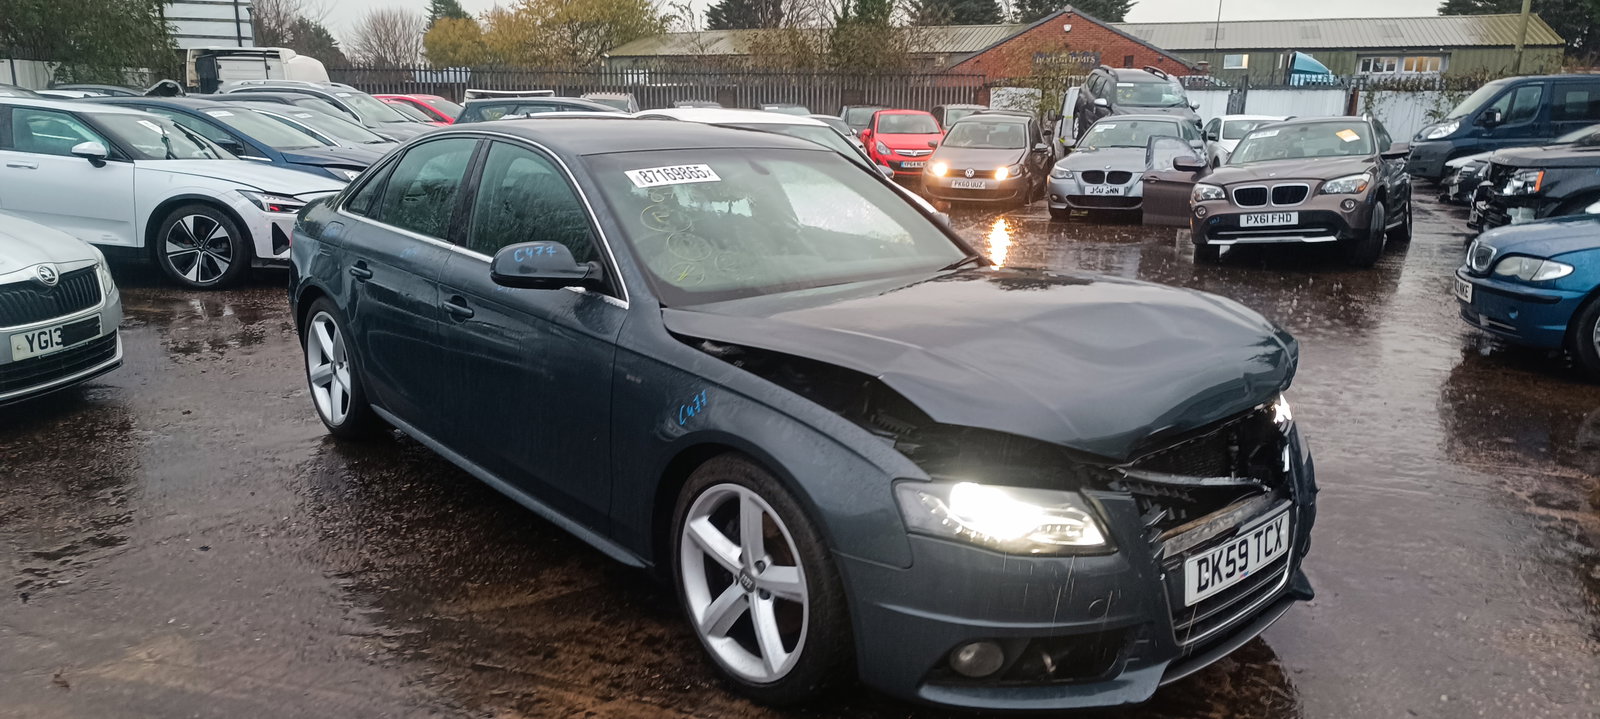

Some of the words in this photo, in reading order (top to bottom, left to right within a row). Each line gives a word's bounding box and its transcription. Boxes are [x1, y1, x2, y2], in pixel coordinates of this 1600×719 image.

[1246, 213, 1269, 225] PX61
[1271, 213, 1292, 223] FHD
[514, 245, 557, 262] C477
[1196, 538, 1249, 594] DK59
[1254, 518, 1284, 564] TCX
